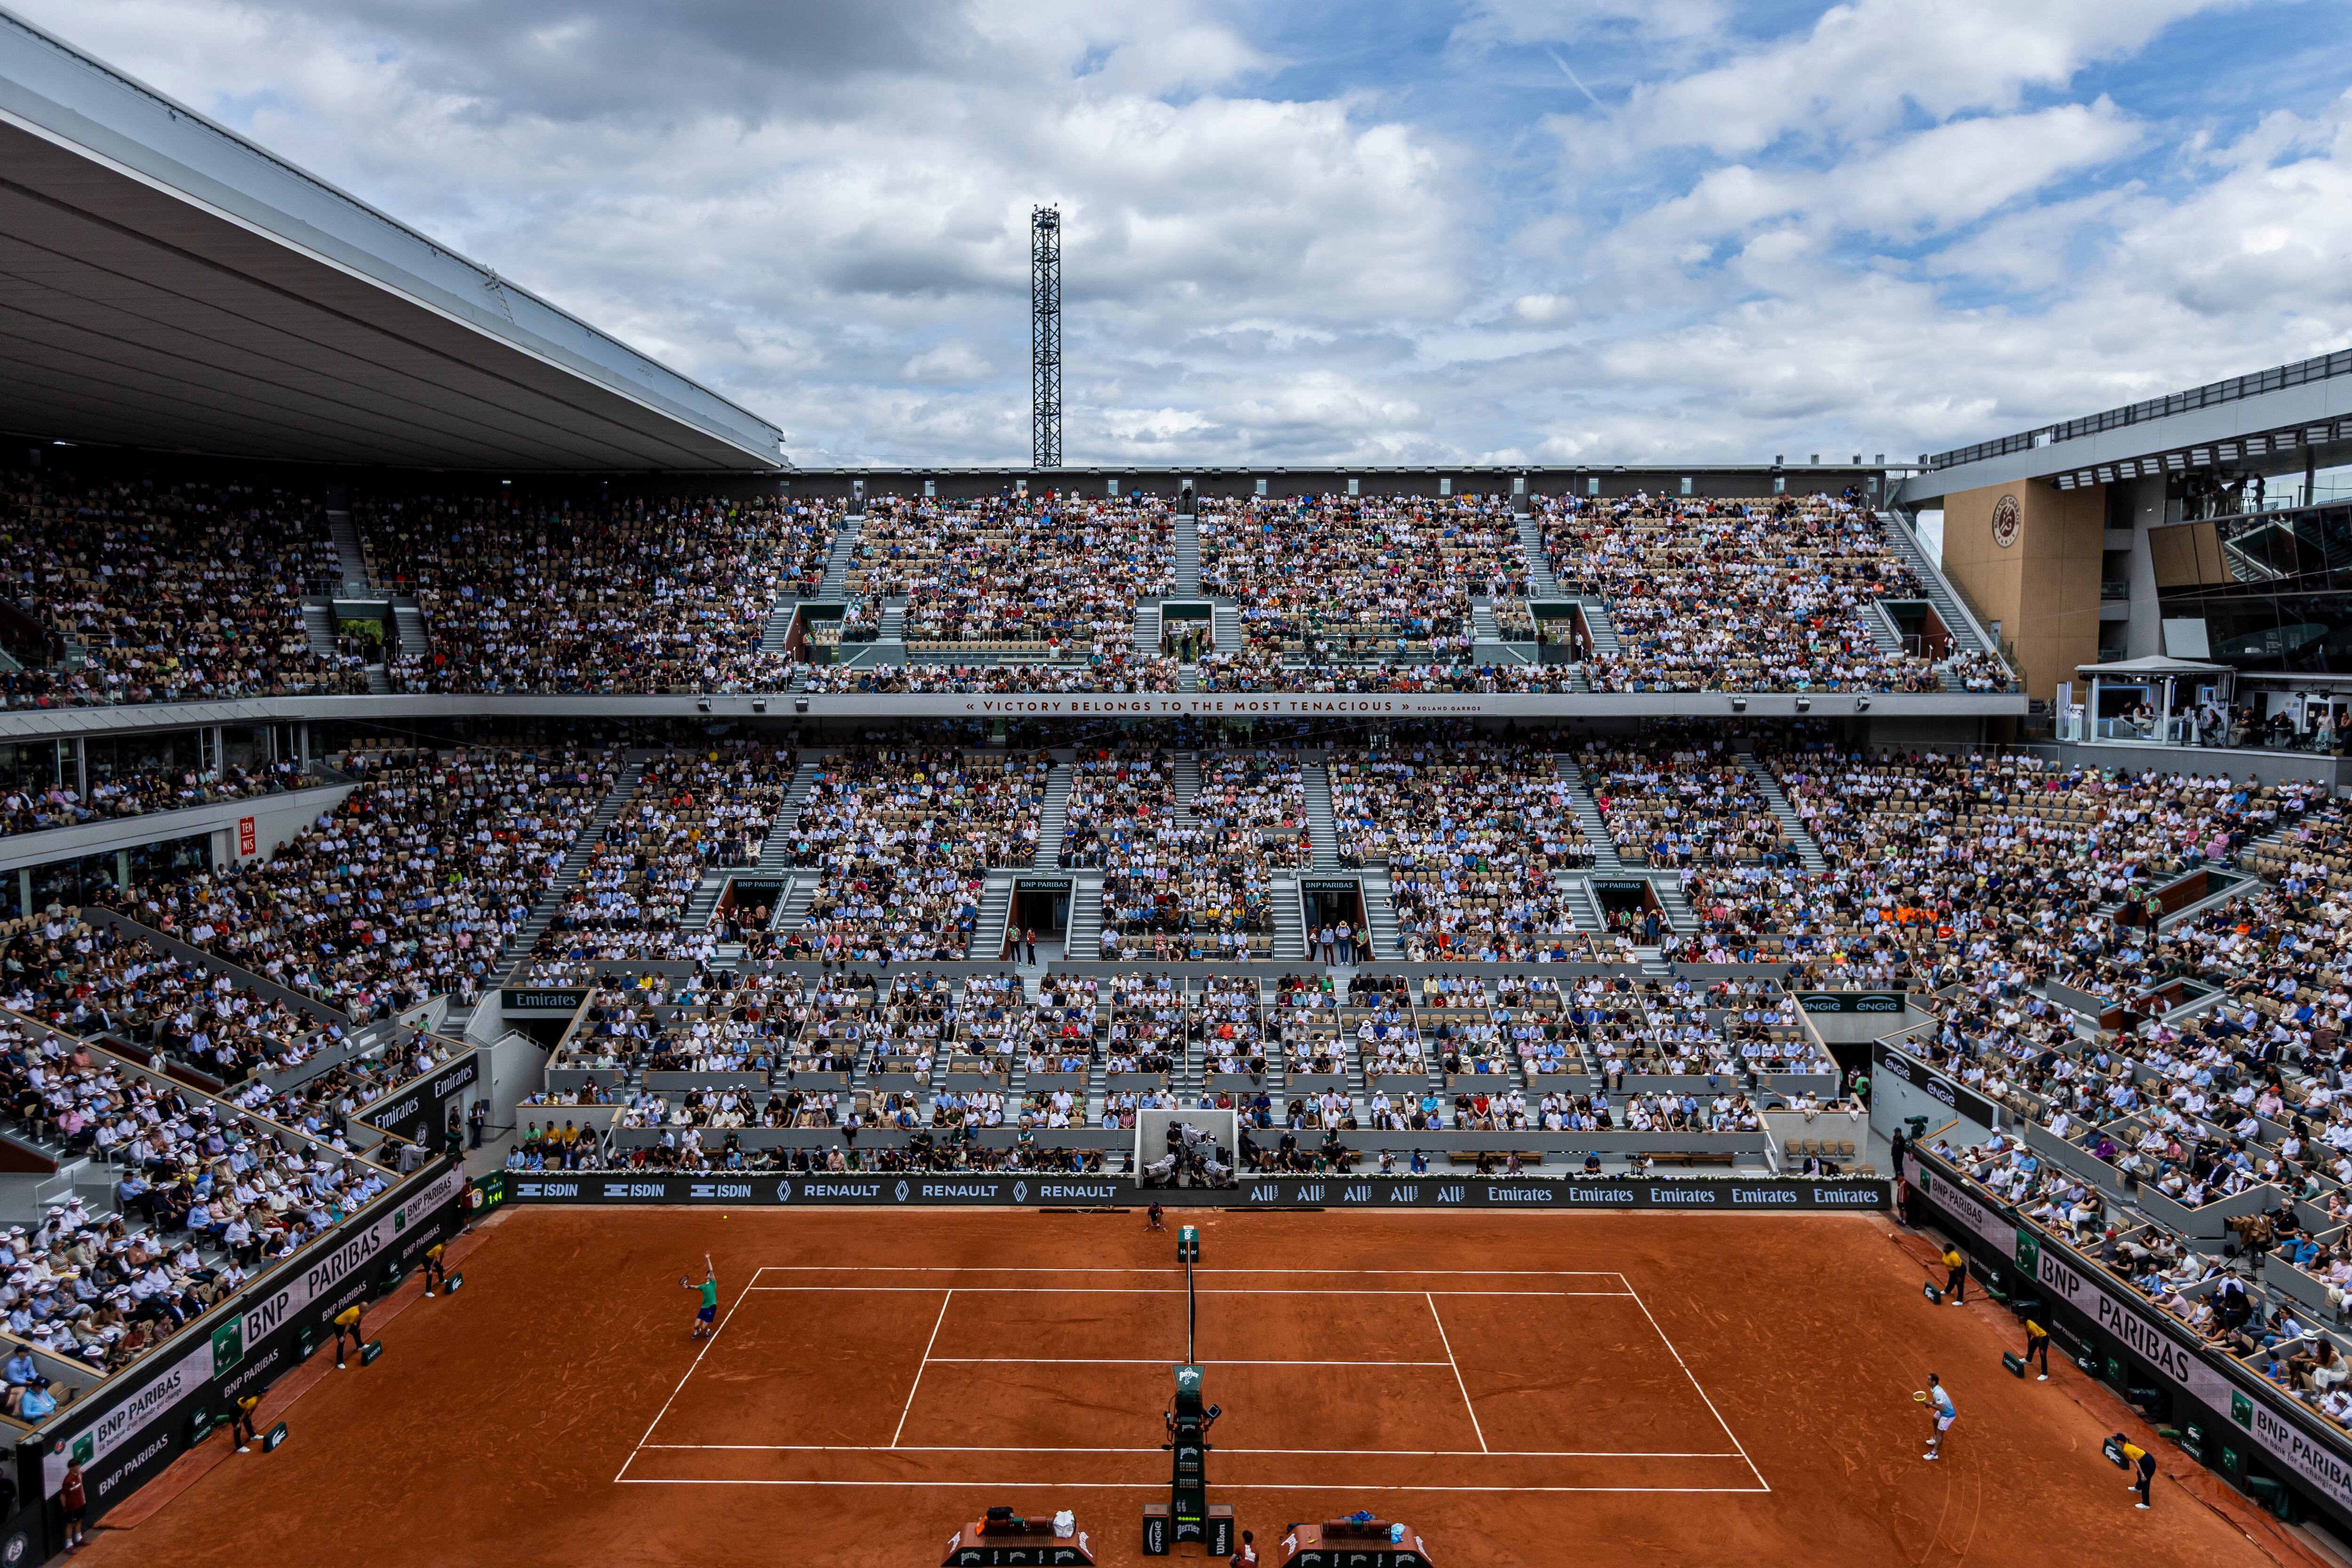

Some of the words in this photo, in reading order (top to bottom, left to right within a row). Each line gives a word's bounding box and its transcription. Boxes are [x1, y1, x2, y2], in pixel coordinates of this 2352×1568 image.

[1994, 498, 2007, 529] ROLAND
[2008, 498, 2019, 525] GARROS
[983, 700, 1061, 711] VICTORY
[1071, 701, 1151, 711] BELONGS
[1163, 701, 1182, 711] TO
[1191, 701, 1224, 711] THE
[1233, 701, 1280, 711] MOST
[1289, 701, 1392, 711] TENACIOUS
[241, 822, 253, 834] TEN
[243, 839, 254, 851] NIS
[516, 993, 577, 1006] Emirates
[434, 1064, 473, 1098] Emirates
[375, 1097, 419, 1129] Emirates
[488, 1181, 502, 1191] ROLEX
[543, 1184, 578, 1197] ISDIN
[630, 1184, 665, 1197] ISDIN
[717, 1185, 752, 1197] ISDIN
[804, 1185, 880, 1196] RENAULT
[922, 1185, 998, 1197] RENAULT
[1041, 1186, 1117, 1198] RENAULT
[1487, 1186, 1552, 1202] Emirates
[407, 1197, 422, 1218] BNP
[424, 1176, 452, 1205] PARIBAS
[488, 1191, 502, 1204] 1:44
[1569, 1187, 1634, 1202] Emirates
[1650, 1187, 1715, 1202] Emirates
[1732, 1188, 1797, 1203] Emirates
[1813, 1188, 1879, 1203] Emirates
[1932, 1178, 1948, 1197] BNP
[1949, 1190, 1982, 1224] PARIBAS
[403, 1243, 416, 1258] BNP
[416, 1224, 440, 1249] PARIBAS
[248, 1291, 289, 1344] BNP
[309, 1225, 381, 1299] PARIBAS
[322, 1304, 337, 1322] BNP
[338, 1281, 367, 1310] PARIBAS
[2042, 1255, 2079, 1299] BNP
[2098, 1295, 2189, 1383] PARIBAS
[2053, 1320, 2062, 1330] BNP
[2062, 1327, 2081, 1345] PARIBAS
[368, 1346, 381, 1360] LACOSTE
[2003, 1358, 2018, 1371] LACOSTE
[224, 1376, 243, 1399] BNP
[244, 1349, 279, 1385] PARIBAS
[98, 1410, 126, 1442] BNP
[129, 1370, 182, 1420] PARIBAS
[106, 1429, 126, 1446] banque
[165, 1387, 182, 1403] change
[194, 1425, 211, 1442] LACOSTE
[2181, 1440, 2200, 1457] LACOSTE
[2257, 1409, 2288, 1443] BNP
[2292, 1435, 2352, 1494] PARIBA
[99, 1469, 122, 1496] BNP
[124, 1433, 169, 1477] PARIBAS
[2257, 1429, 2268, 1443] The
[2270, 1438, 2285, 1457] bank
[2287, 1452, 2297, 1464] for
[2305, 1466, 2338, 1496] changing
[1216, 1524, 1225, 1554] Wilson
